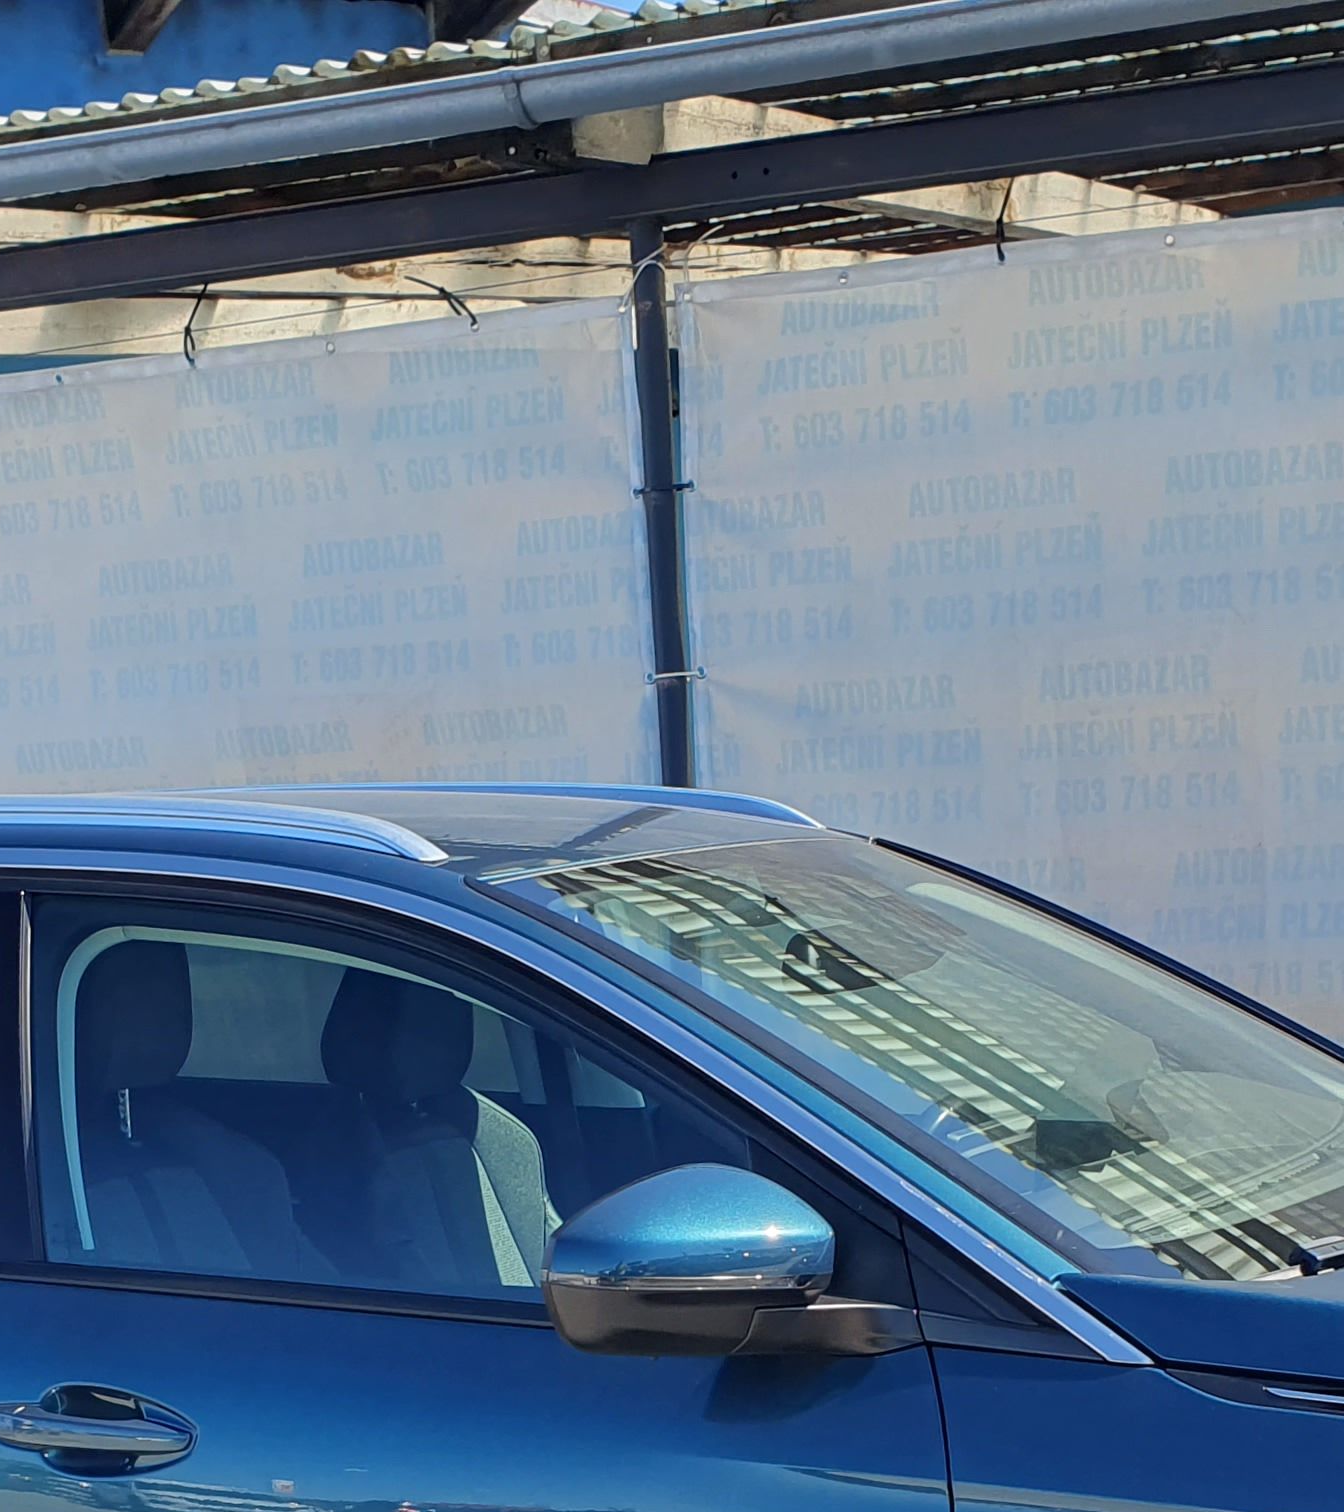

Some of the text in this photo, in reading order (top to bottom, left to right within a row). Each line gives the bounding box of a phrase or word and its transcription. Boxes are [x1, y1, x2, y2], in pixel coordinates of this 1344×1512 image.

[1028, 257, 1205, 307] AUTOBAZAR
[781, 281, 941, 337] AUTOBAZAR
[389, 335, 540, 385] AUTOBAZAR
[1273, 364, 1296, 402] T:
[175, 363, 315, 409] AUTOBAZAR
[1008, 371, 1232, 429] T: 603 718 514
[760, 399, 971, 452] T: 603 718 514
[199, 478, 242, 515] 603
[255, 474, 296, 508] 718
[305, 467, 349, 502] 514
[405, 455, 453, 493] 603
[462, 447, 507, 485] 718
[519, 443, 565, 482] 514
[909, 466, 1078, 518] AUTOBAZAR
[1165, 441, 1344, 495] AUTOBAZAR
[0, 504, 40, 537] 603
[48, 497, 91, 531] 718
[102, 490, 143, 526] 514
[98, 552, 234, 598] AUTOBAZAR
[303, 532, 444, 579] AUTOBAZAR
[924, 594, 974, 632] 603
[990, 590, 1038, 626] 718
[1051, 584, 1103, 619] 514
[1141, 577, 1164, 614] T:
[1178, 573, 1232, 612] 603
[1248, 568, 1302, 605] 718
[1040, 653, 1211, 701] AUTOBAZAR
[1057, 776, 1107, 815] 603
[1120, 774, 1170, 811] 718
[1186, 771, 1240, 806] 514
